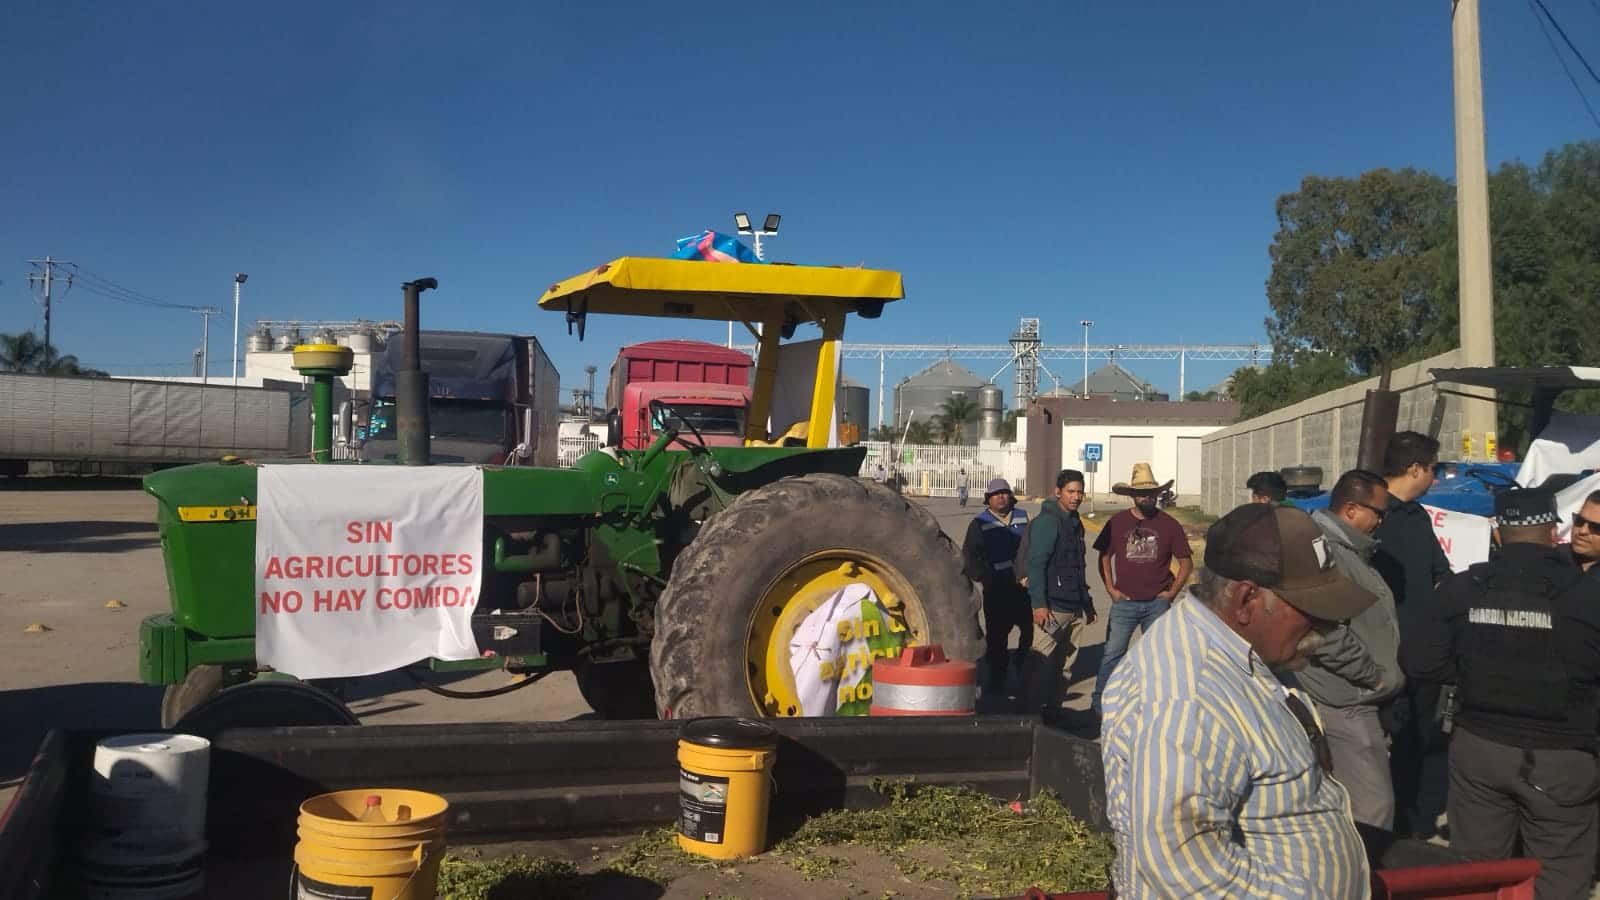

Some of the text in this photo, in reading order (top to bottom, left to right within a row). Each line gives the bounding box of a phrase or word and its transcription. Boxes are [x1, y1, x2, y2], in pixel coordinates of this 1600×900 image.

[346, 520, 393, 544] SIN
[264, 553, 474, 580] AGRICULTORES
[261, 585, 475, 615] NO HAY COMIDA
[1469, 607, 1553, 629] GUARDIA NACIONAL
